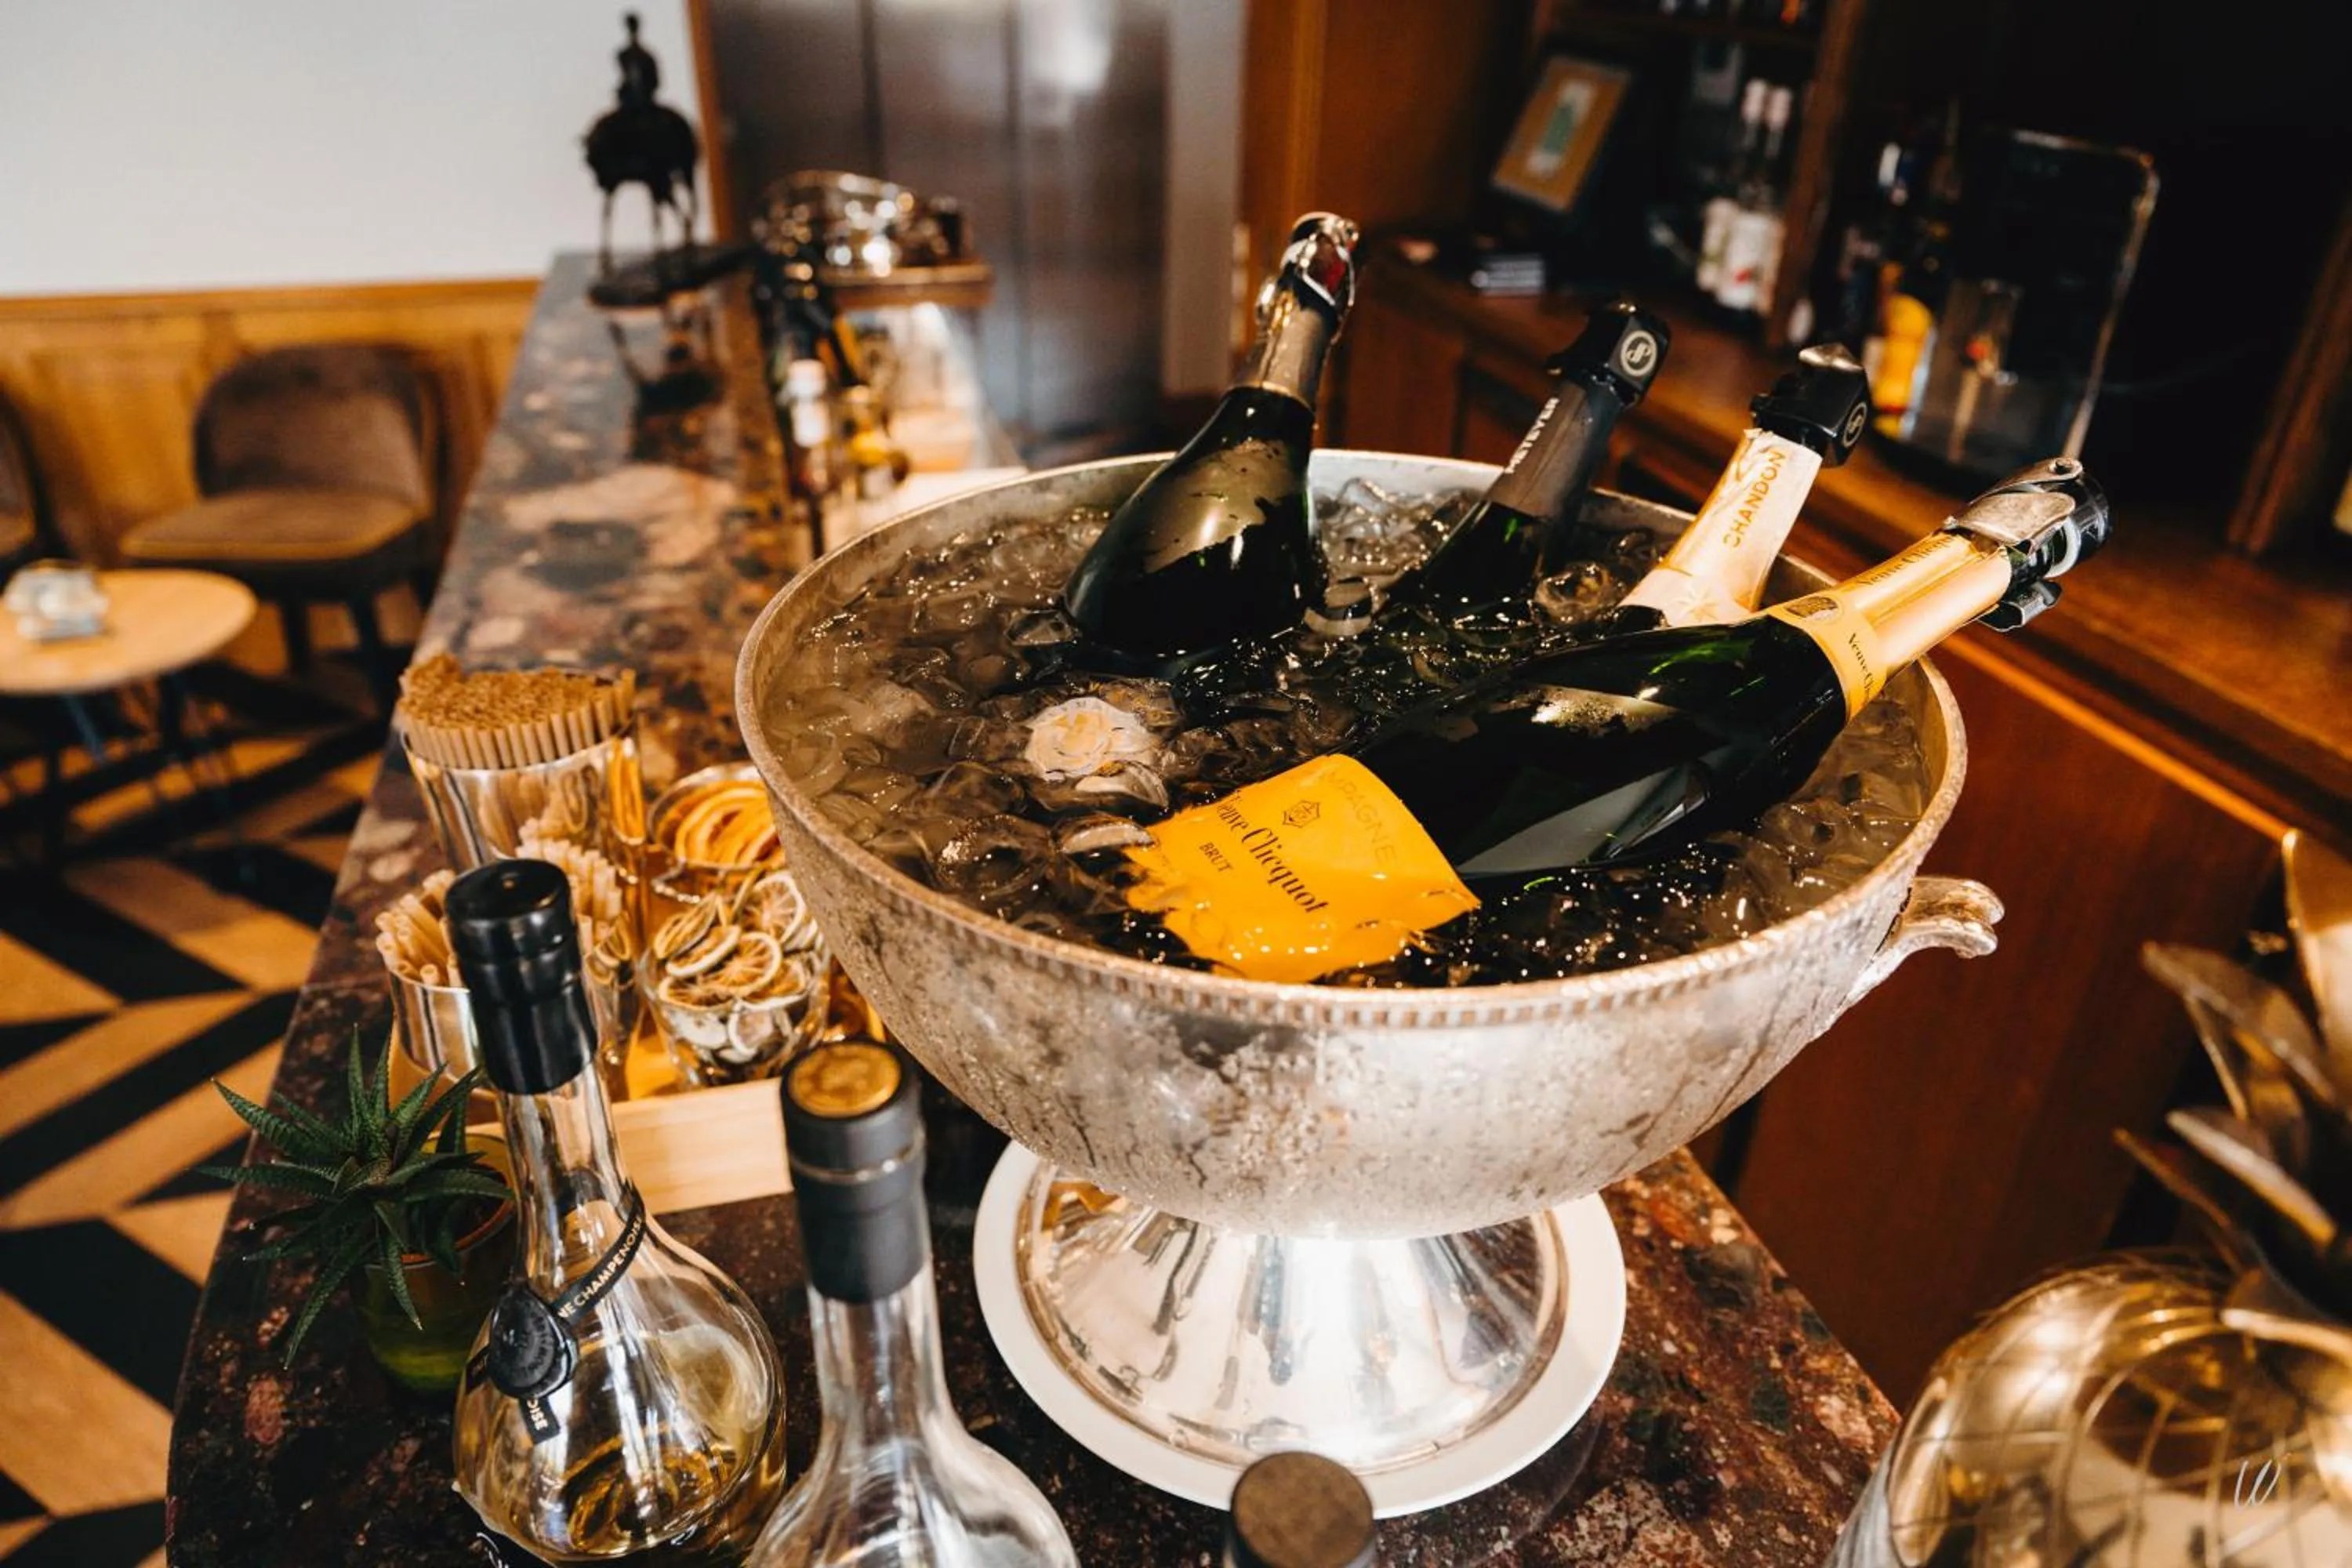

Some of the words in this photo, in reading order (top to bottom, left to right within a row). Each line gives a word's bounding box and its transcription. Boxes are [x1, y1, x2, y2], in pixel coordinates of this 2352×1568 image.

[1722, 448, 1786, 547] CHANDON
[1199, 841, 1233, 872] BRUT
[1241, 827, 1329, 913] Clicquot
